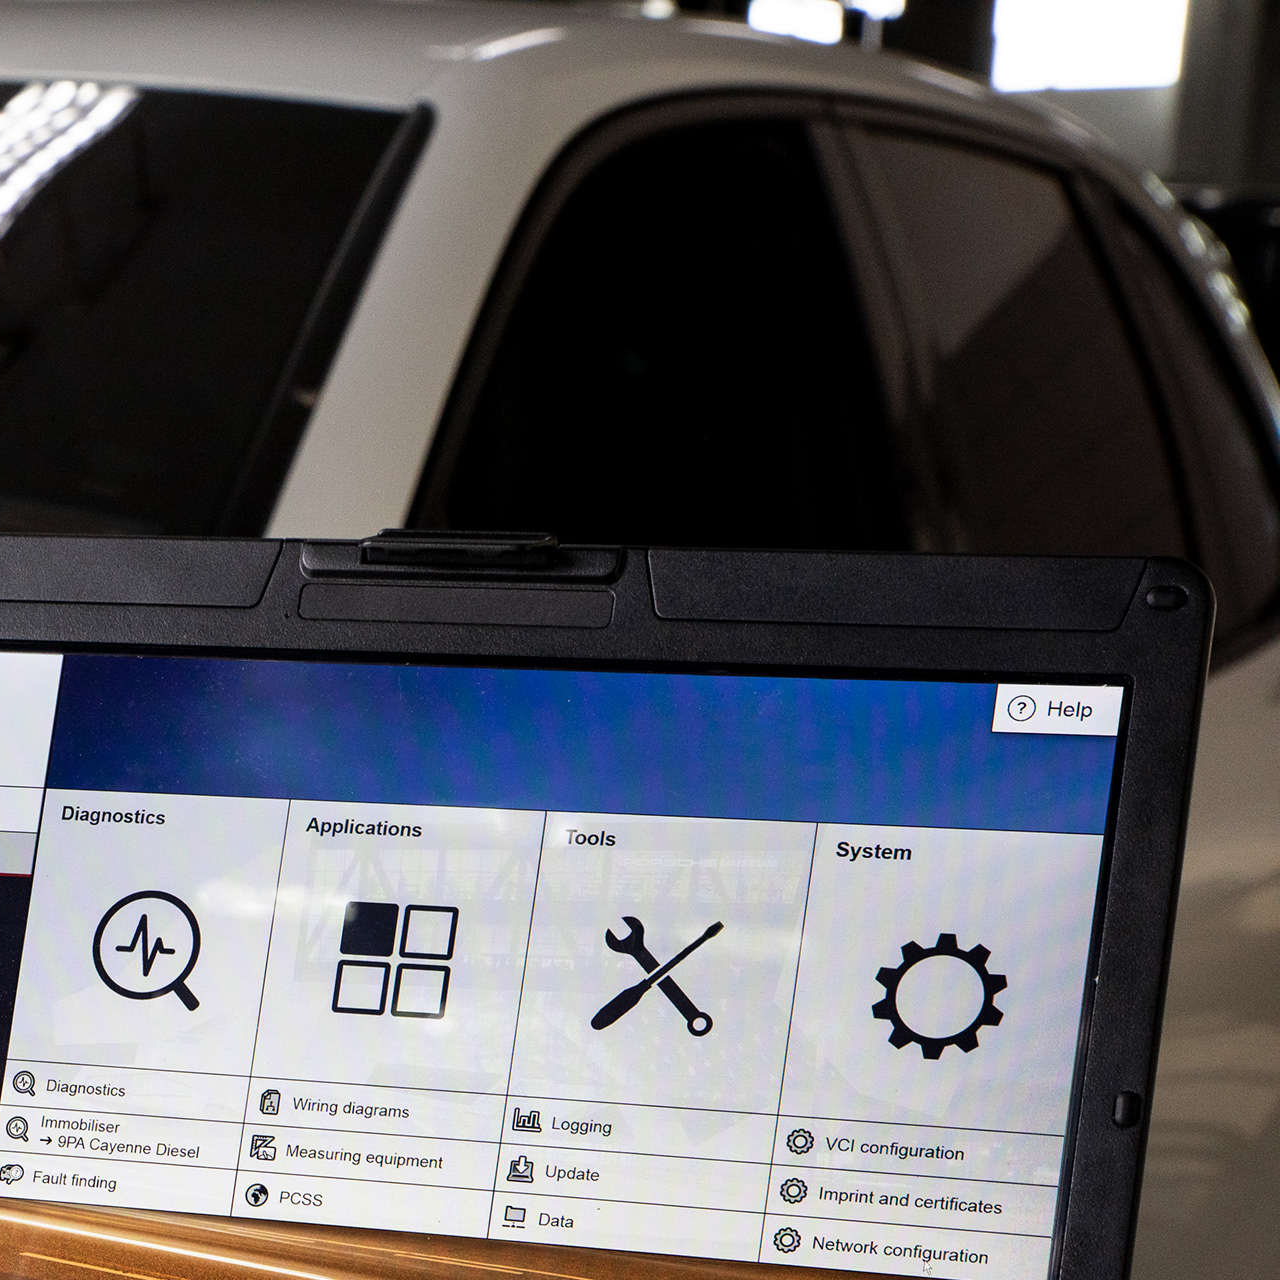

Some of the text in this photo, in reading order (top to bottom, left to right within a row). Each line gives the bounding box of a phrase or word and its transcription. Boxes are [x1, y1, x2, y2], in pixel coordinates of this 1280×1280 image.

[1046, 699, 1093, 721] Help
[61, 805, 166, 826] Diagnostics
[306, 817, 422, 838] Applications
[565, 828, 617, 848] Tools
[836, 840, 913, 862] System
[46, 1079, 126, 1098] Diagnostics
[292, 1098, 410, 1119] Wiring diagrams
[40, 1116, 120, 1134] Immobiliser
[551, 1117, 612, 1138] Logging
[57, 1135, 200, 1159] 9PA Cayenne Diesel
[285, 1144, 443, 1171] Measuring equipment
[825, 1136, 965, 1162] VCI configuration
[32, 1170, 117, 1193] Fault finding
[545, 1165, 600, 1184] Update
[279, 1191, 324, 1207] PCSS
[818, 1187, 1003, 1215] Imprint and certificates
[538, 1213, 574, 1229] Data
[812, 1236, 989, 1264] Network configuration
